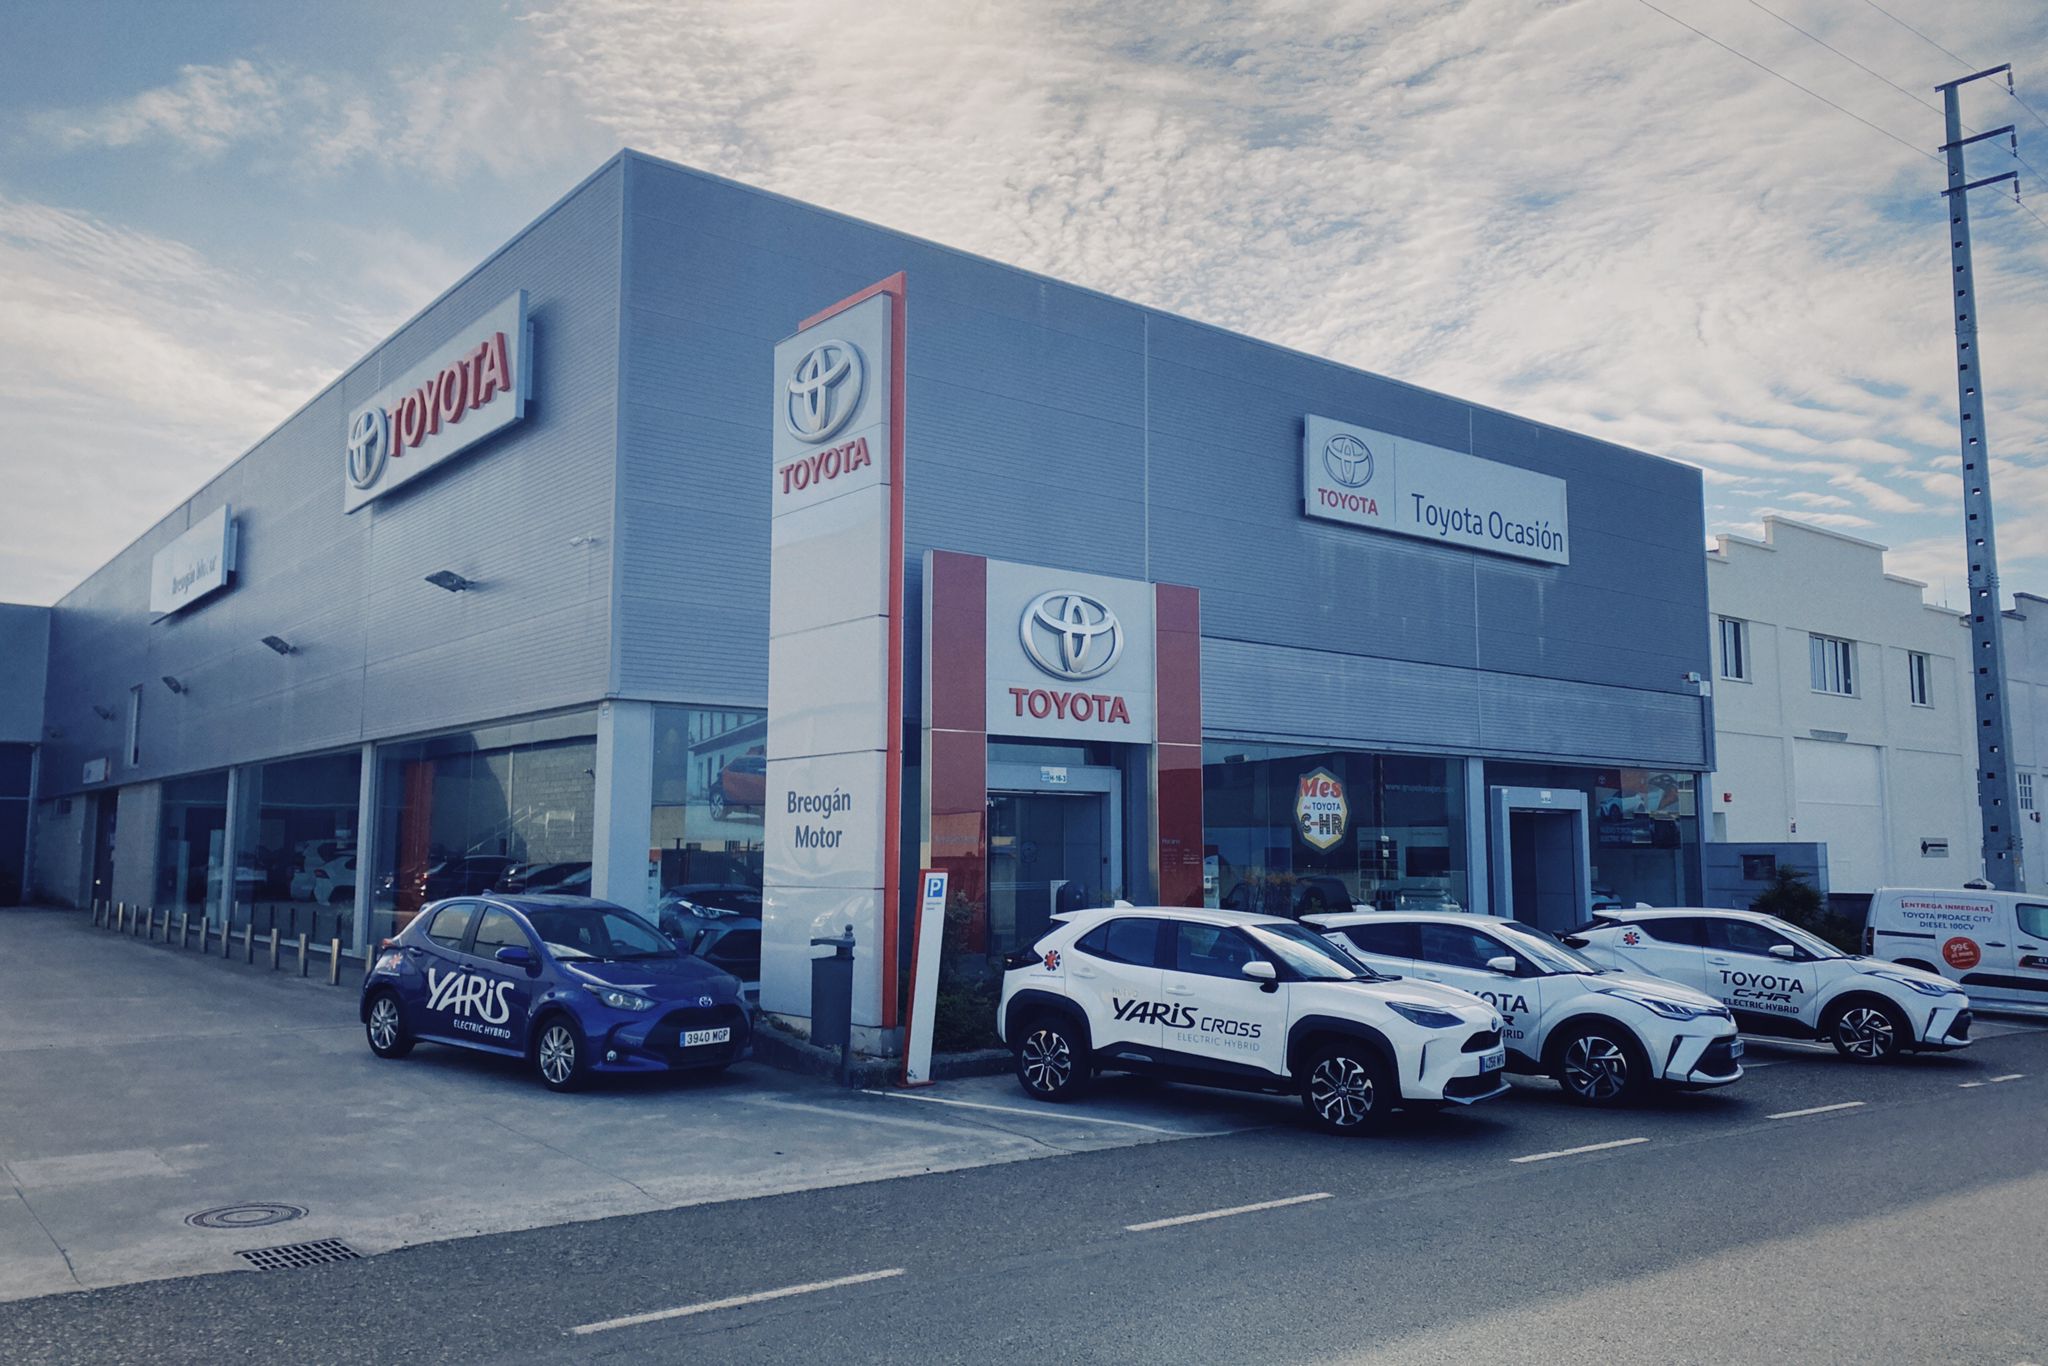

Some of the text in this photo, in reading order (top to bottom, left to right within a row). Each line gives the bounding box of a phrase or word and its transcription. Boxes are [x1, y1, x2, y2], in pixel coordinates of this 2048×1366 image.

[387, 331, 511, 458] TOYOTA
[780, 437, 871, 494] TOYOTA
[1318, 488, 1379, 516] TOYOTA
[1411, 493, 1564, 552] Toyota Ocasión
[1009, 687, 1130, 724] TOYOTA
[1299, 777, 1342, 798] Mes
[787, 787, 851, 819] Breogán
[1311, 802, 1341, 811] TOYOTA
[1301, 813, 1344, 835] C-HR
[795, 825, 842, 848] Motor
[1902, 912, 1993, 923] TOYOTA PROACE CITY
[1920, 921, 1974, 931] DIESEL 100CV
[1720, 970, 1804, 994] TOYOTA
[1723, 997, 1799, 1014] ELECTRIC HYBRID
[1733, 989, 1792, 1003] C-HR
[453, 1019, 511, 1039] ELECTRIC HYBRID
[687, 1031, 710, 1045] 3940
[1201, 1017, 1262, 1038] CROSS
[1177, 1032, 1261, 1051] ELECTRIC HYBRID
